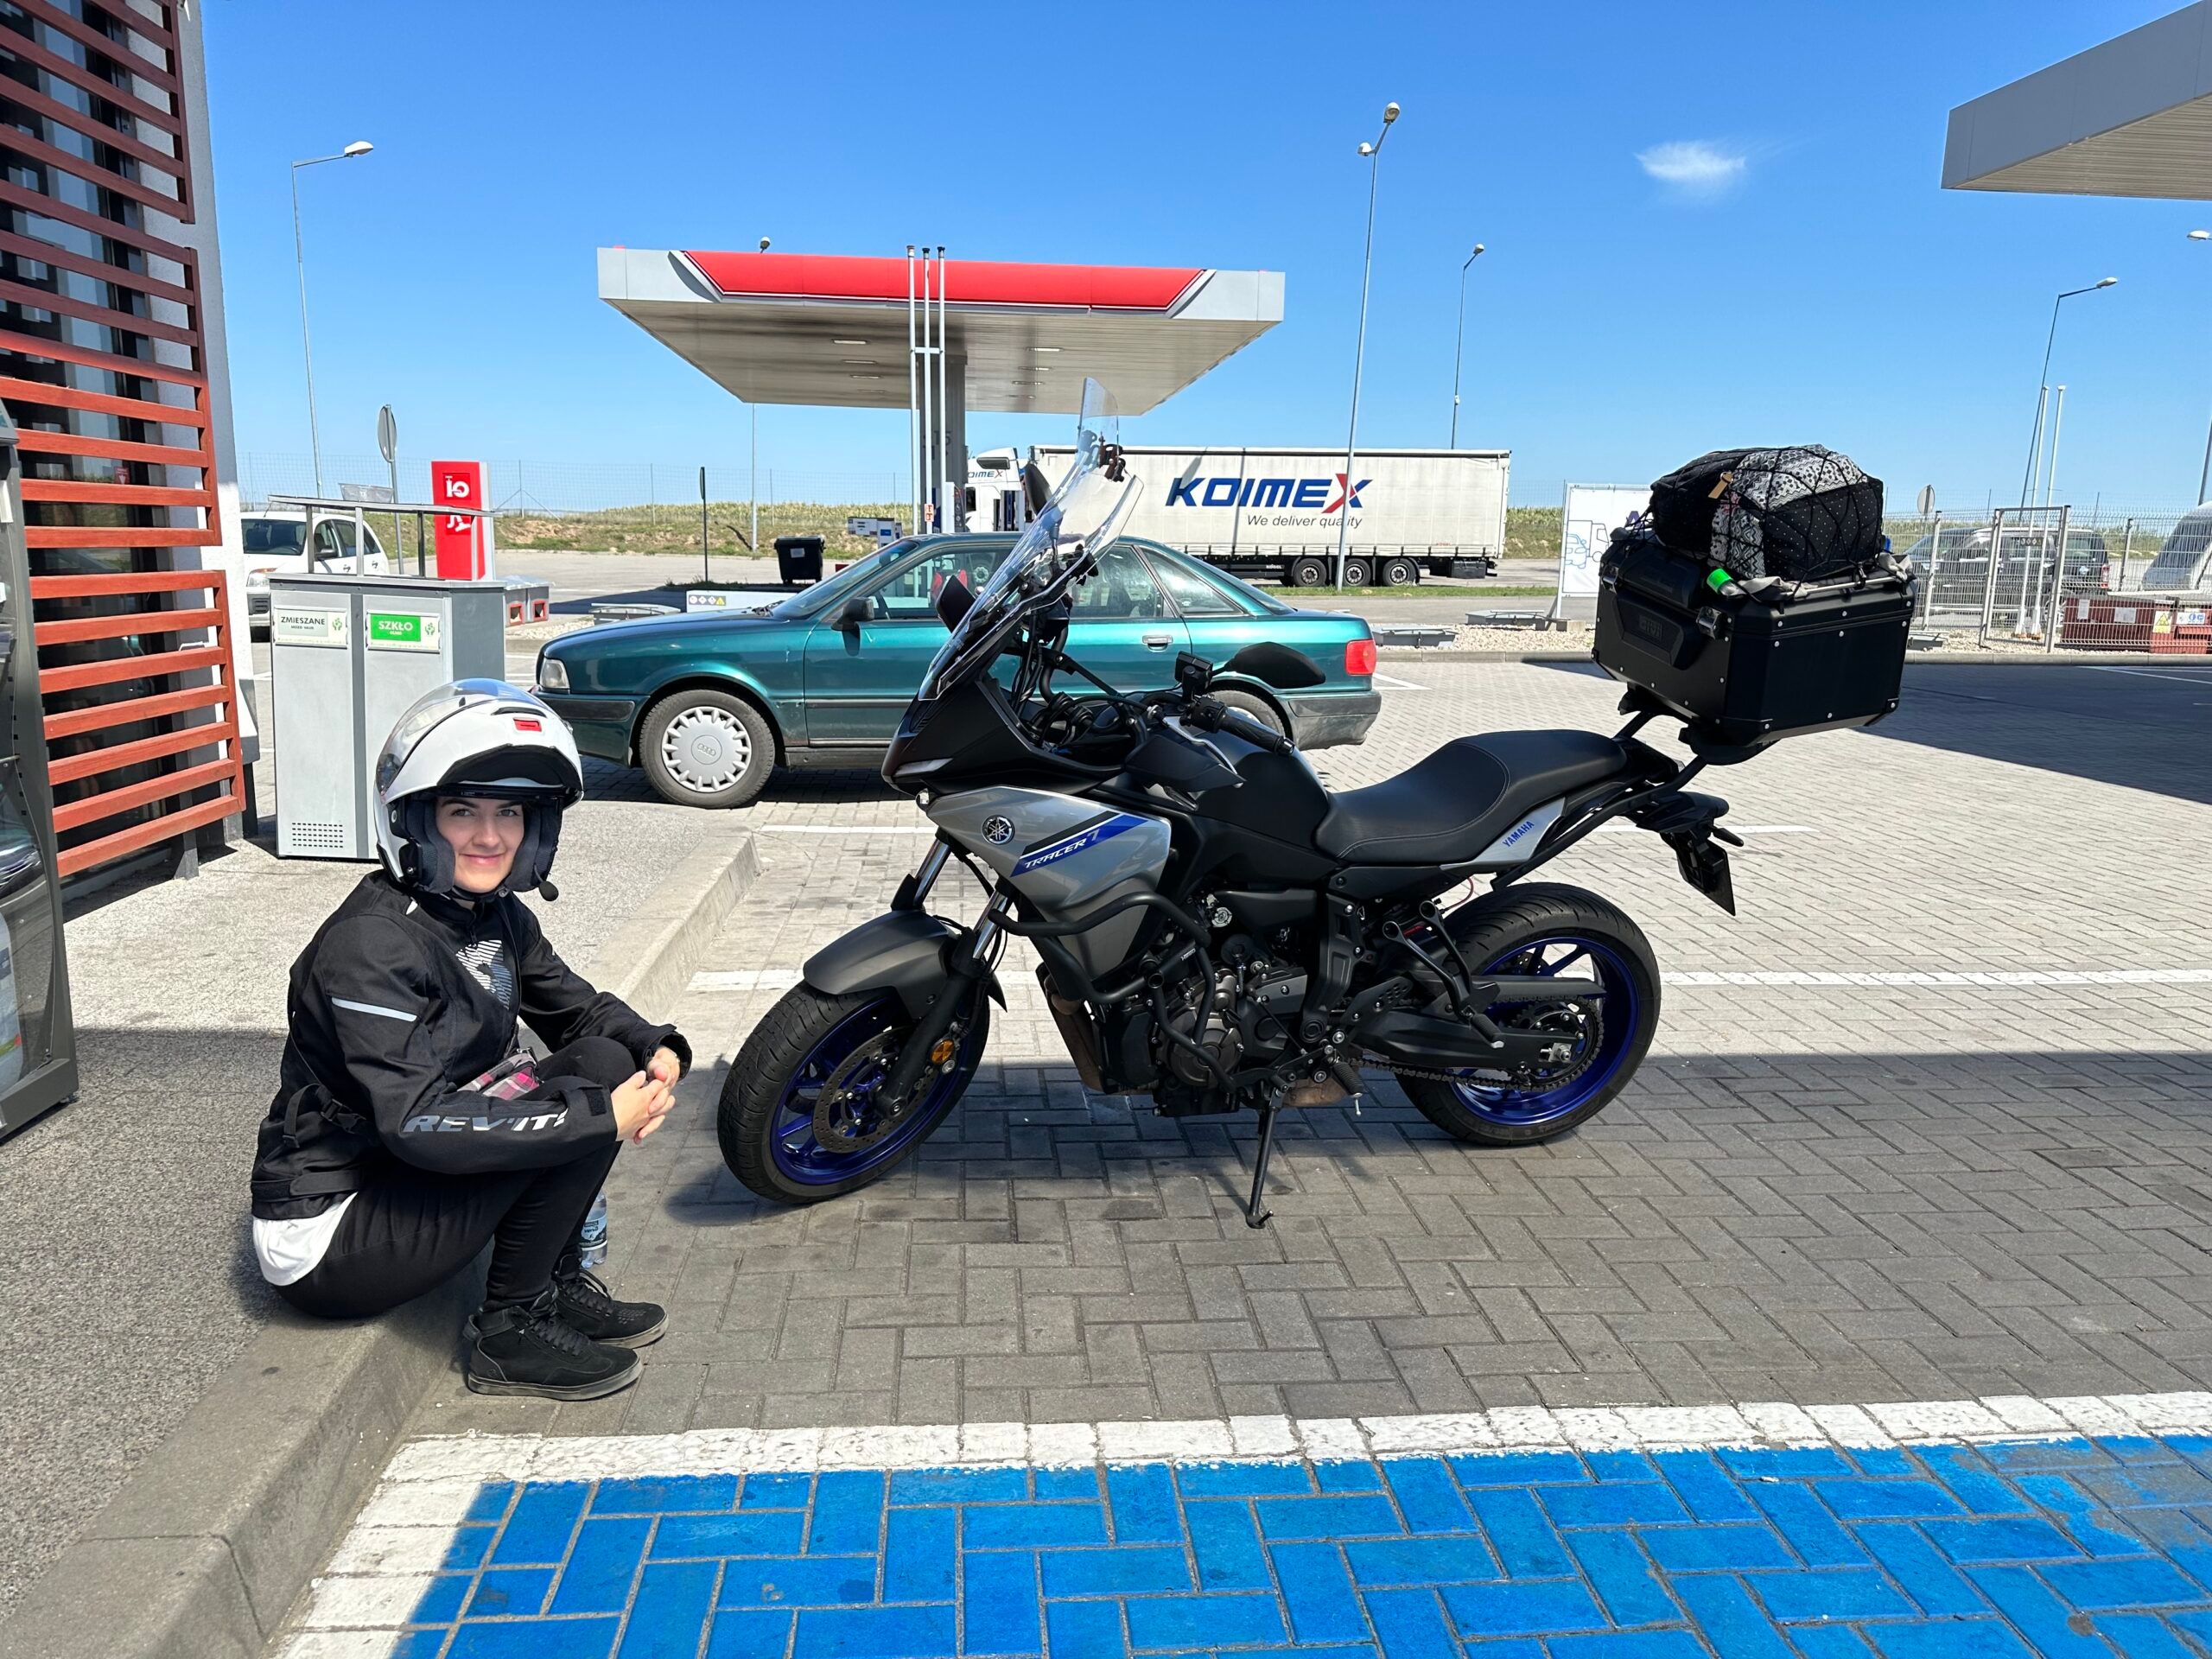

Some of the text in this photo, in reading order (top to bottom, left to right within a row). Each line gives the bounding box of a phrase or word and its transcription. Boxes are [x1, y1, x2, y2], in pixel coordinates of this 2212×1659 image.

[968, 469, 1003, 479] OIMEX
[1165, 474, 1374, 514] KOIMEX
[1247, 515, 1363, 529] We deliver quaity
[280, 616, 326, 626] ZMIESZANE
[378, 620, 414, 632] SZKŁO
[1502, 821, 1535, 847] YAMAHA
[1024, 828, 1101, 868] TRACER 7
